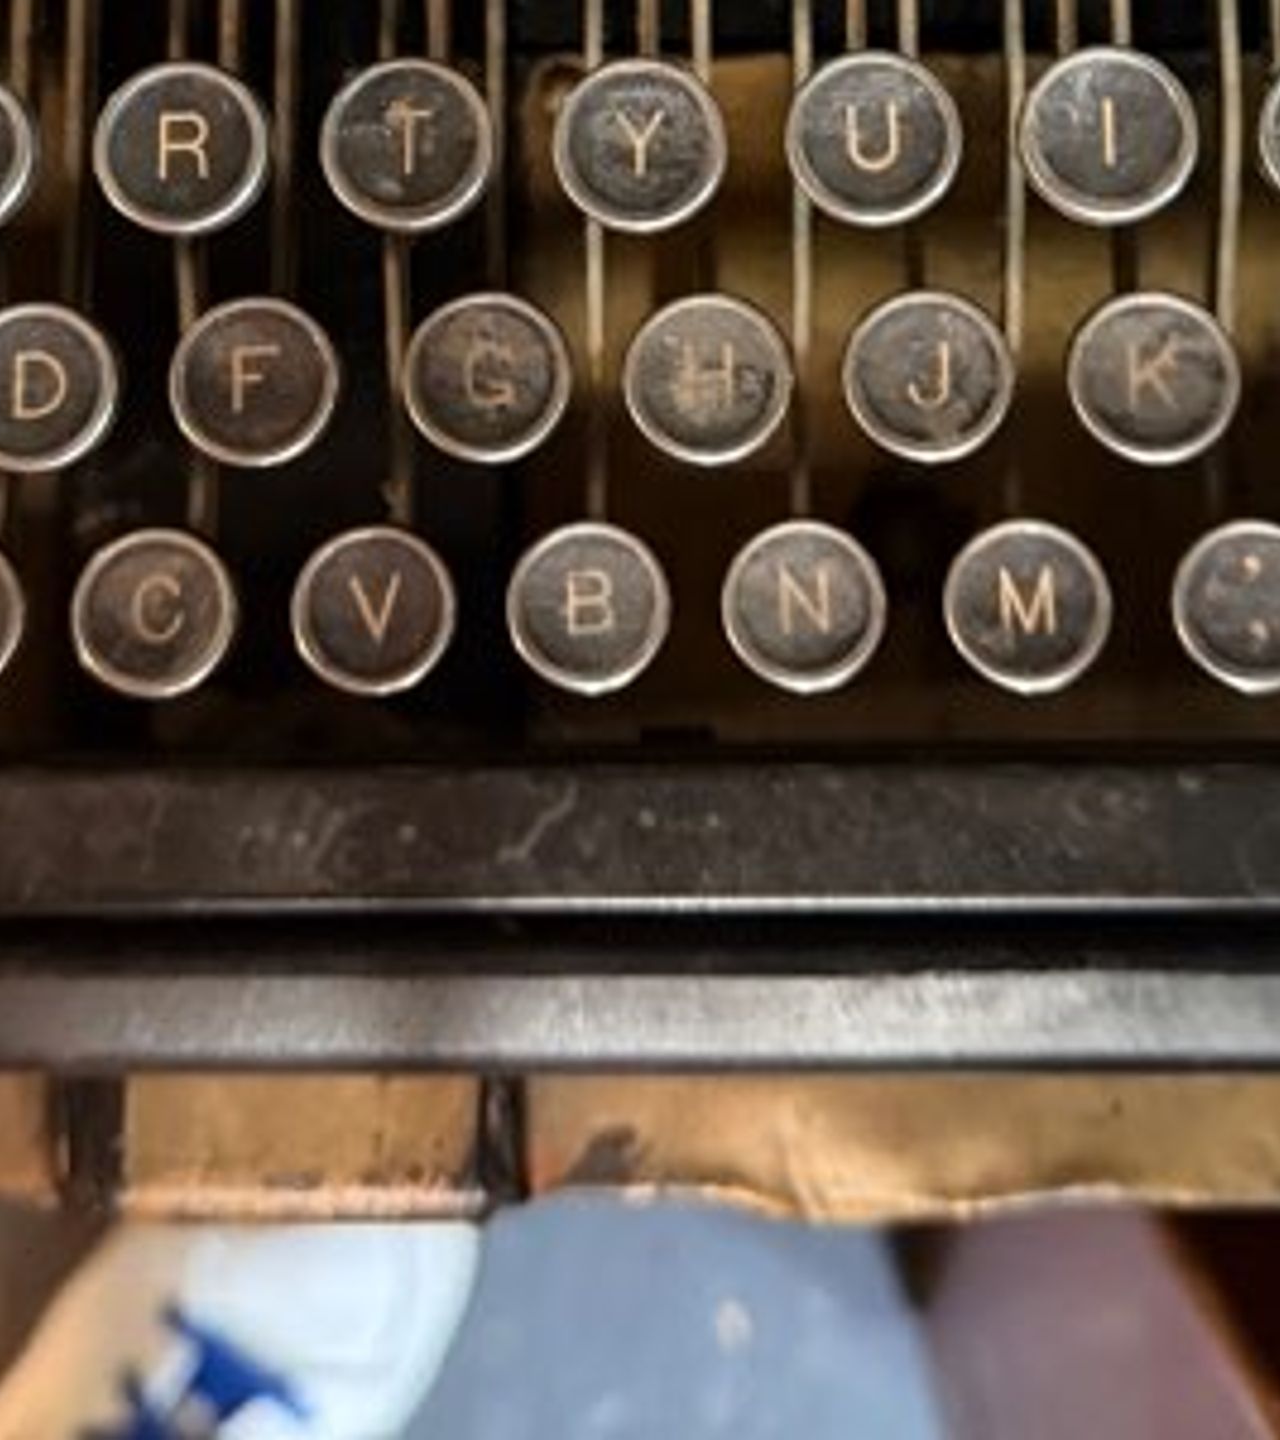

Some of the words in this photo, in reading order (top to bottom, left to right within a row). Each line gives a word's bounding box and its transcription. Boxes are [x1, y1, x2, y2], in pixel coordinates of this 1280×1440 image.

[157, 112, 209, 180] R
[388, 111, 430, 174] T
[617, 111, 663, 176] Y
[845, 104, 899, 171] U
[1101, 97, 1116, 166] I
[11, 351, 66, 419] D
[230, 345, 280, 413] F
[461, 343, 517, 406] G
[681, 342, 733, 406] H
[909, 341, 949, 405] J
[1129, 339, 1179, 410] K
[131, 577, 183, 641] C
[350, 574, 402, 642] V
[565, 570, 615, 635] B
[776, 565, 831, 634] N
[997, 566, 1056, 635] M
